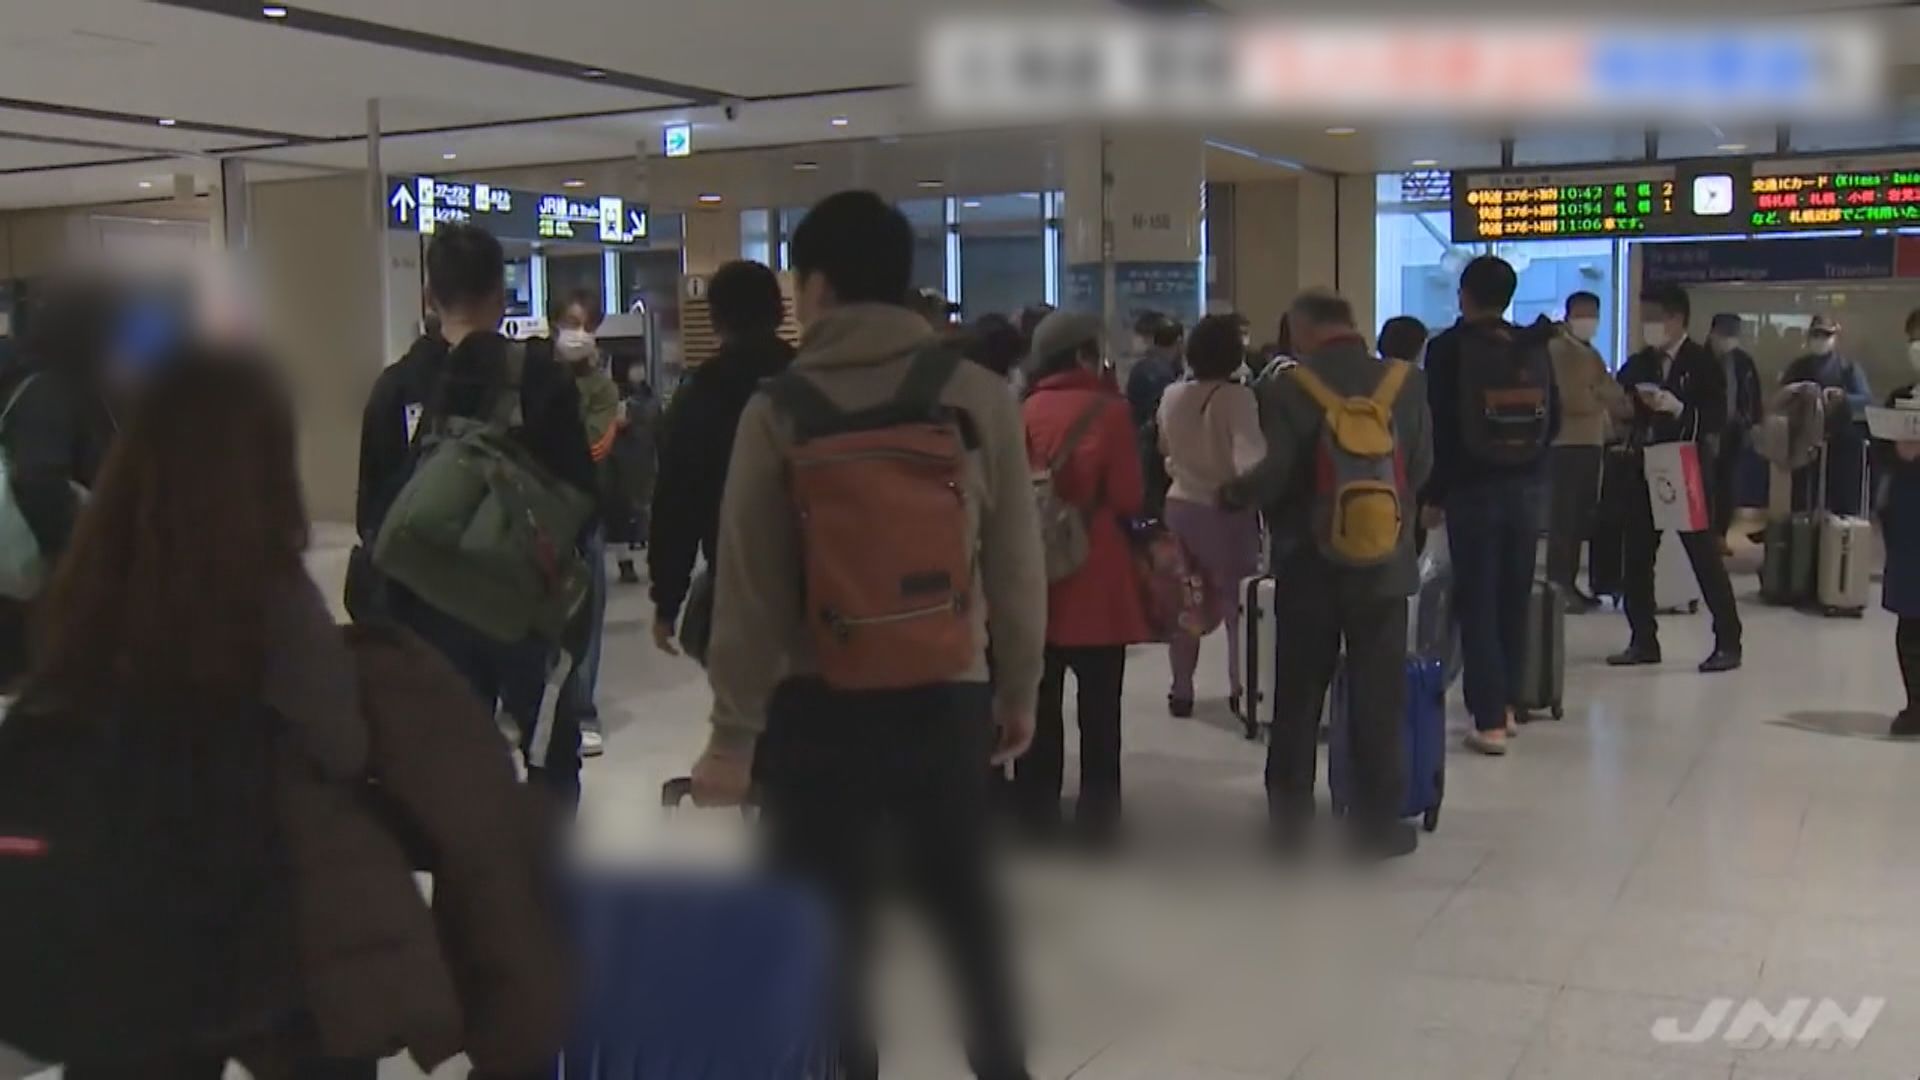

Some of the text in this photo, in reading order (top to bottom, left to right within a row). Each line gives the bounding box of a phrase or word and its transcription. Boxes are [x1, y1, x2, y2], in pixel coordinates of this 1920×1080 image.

[1663, 182, 1673, 196] 2
[1663, 199, 1673, 212] 1
[1560, 218, 1602, 232] 11:06
